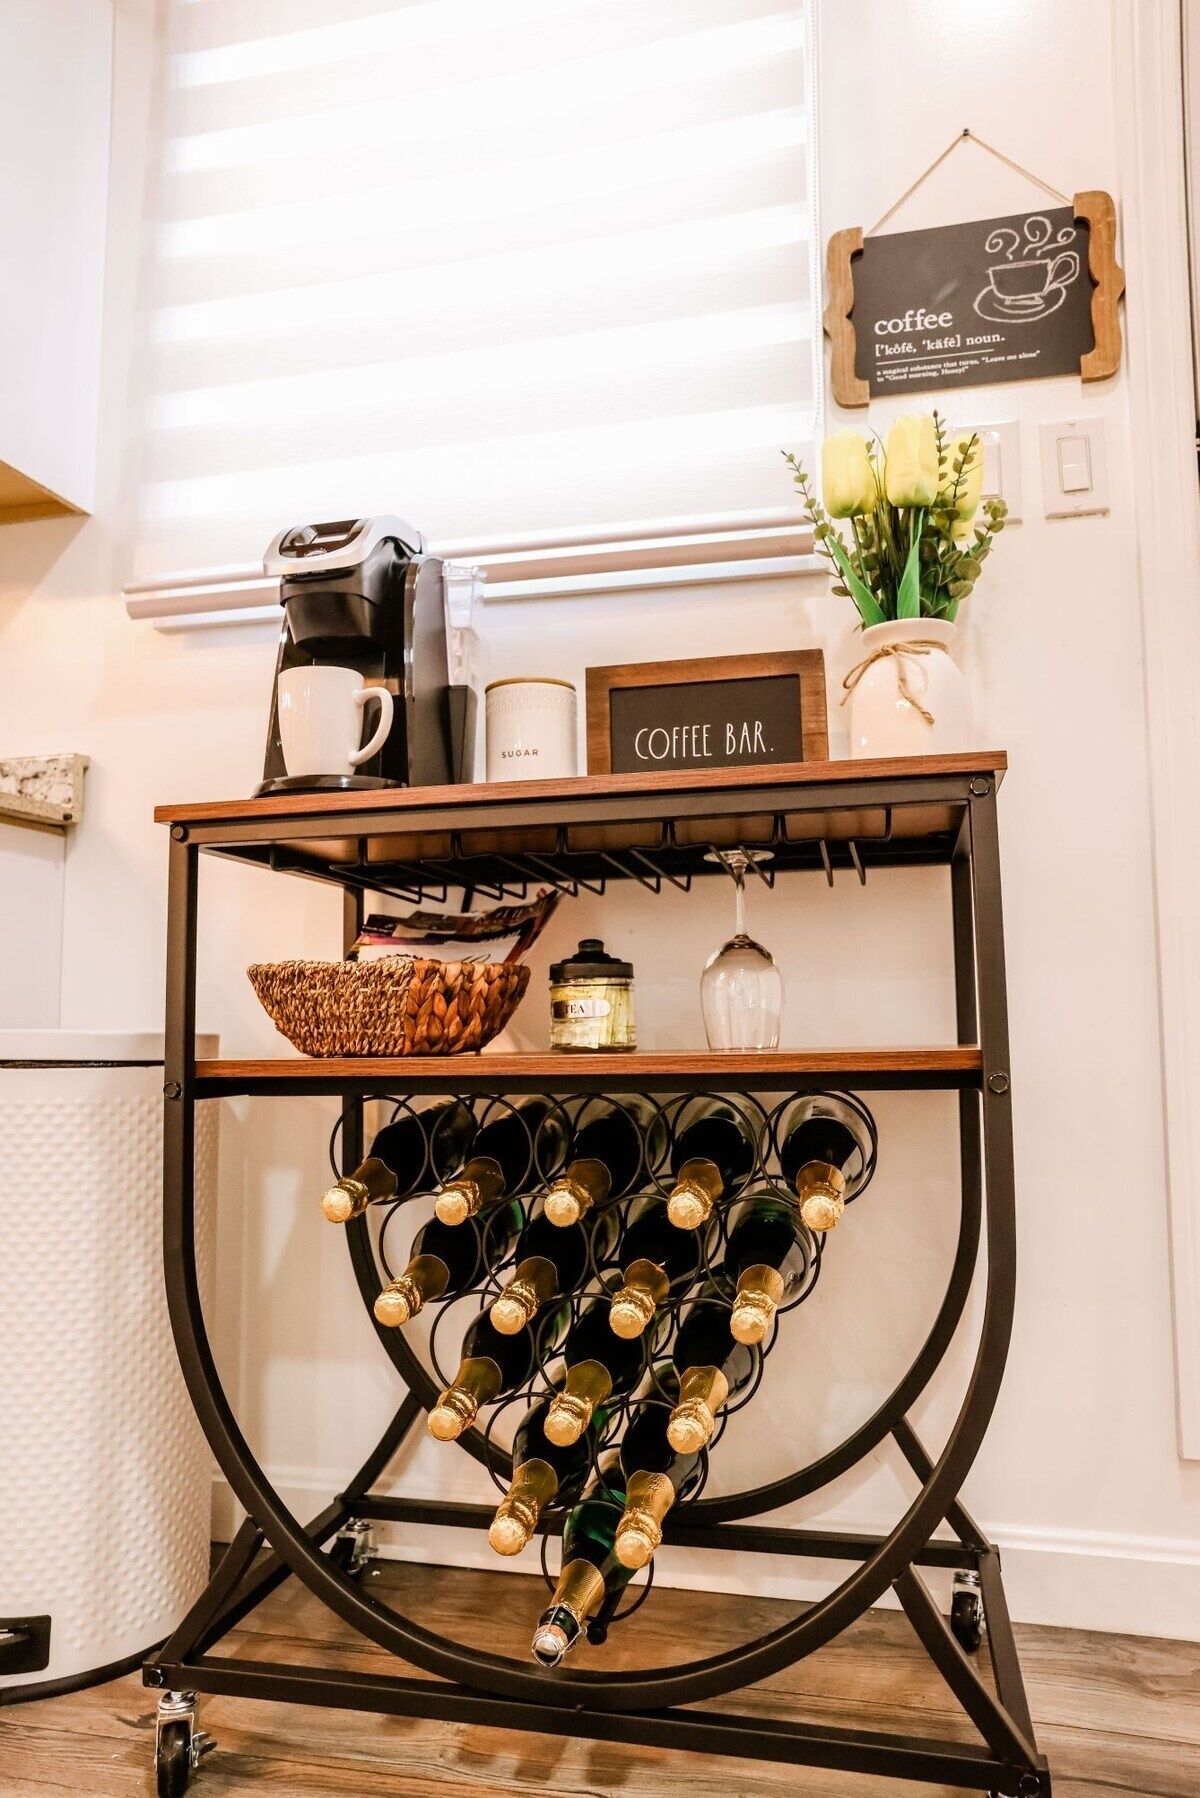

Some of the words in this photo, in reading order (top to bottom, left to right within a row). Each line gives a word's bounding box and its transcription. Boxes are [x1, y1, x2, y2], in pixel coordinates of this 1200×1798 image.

[874, 308, 953, 335] coffee
[966, 334, 1006, 346] noun.
[882, 366, 909, 376] magical
[910, 362, 942, 373] substance
[635, 724, 712, 760] COFFEE
[726, 720, 774, 755] BAR.
[501, 749, 539, 759] SUGAR
[564, 1004, 585, 1014] TEA
